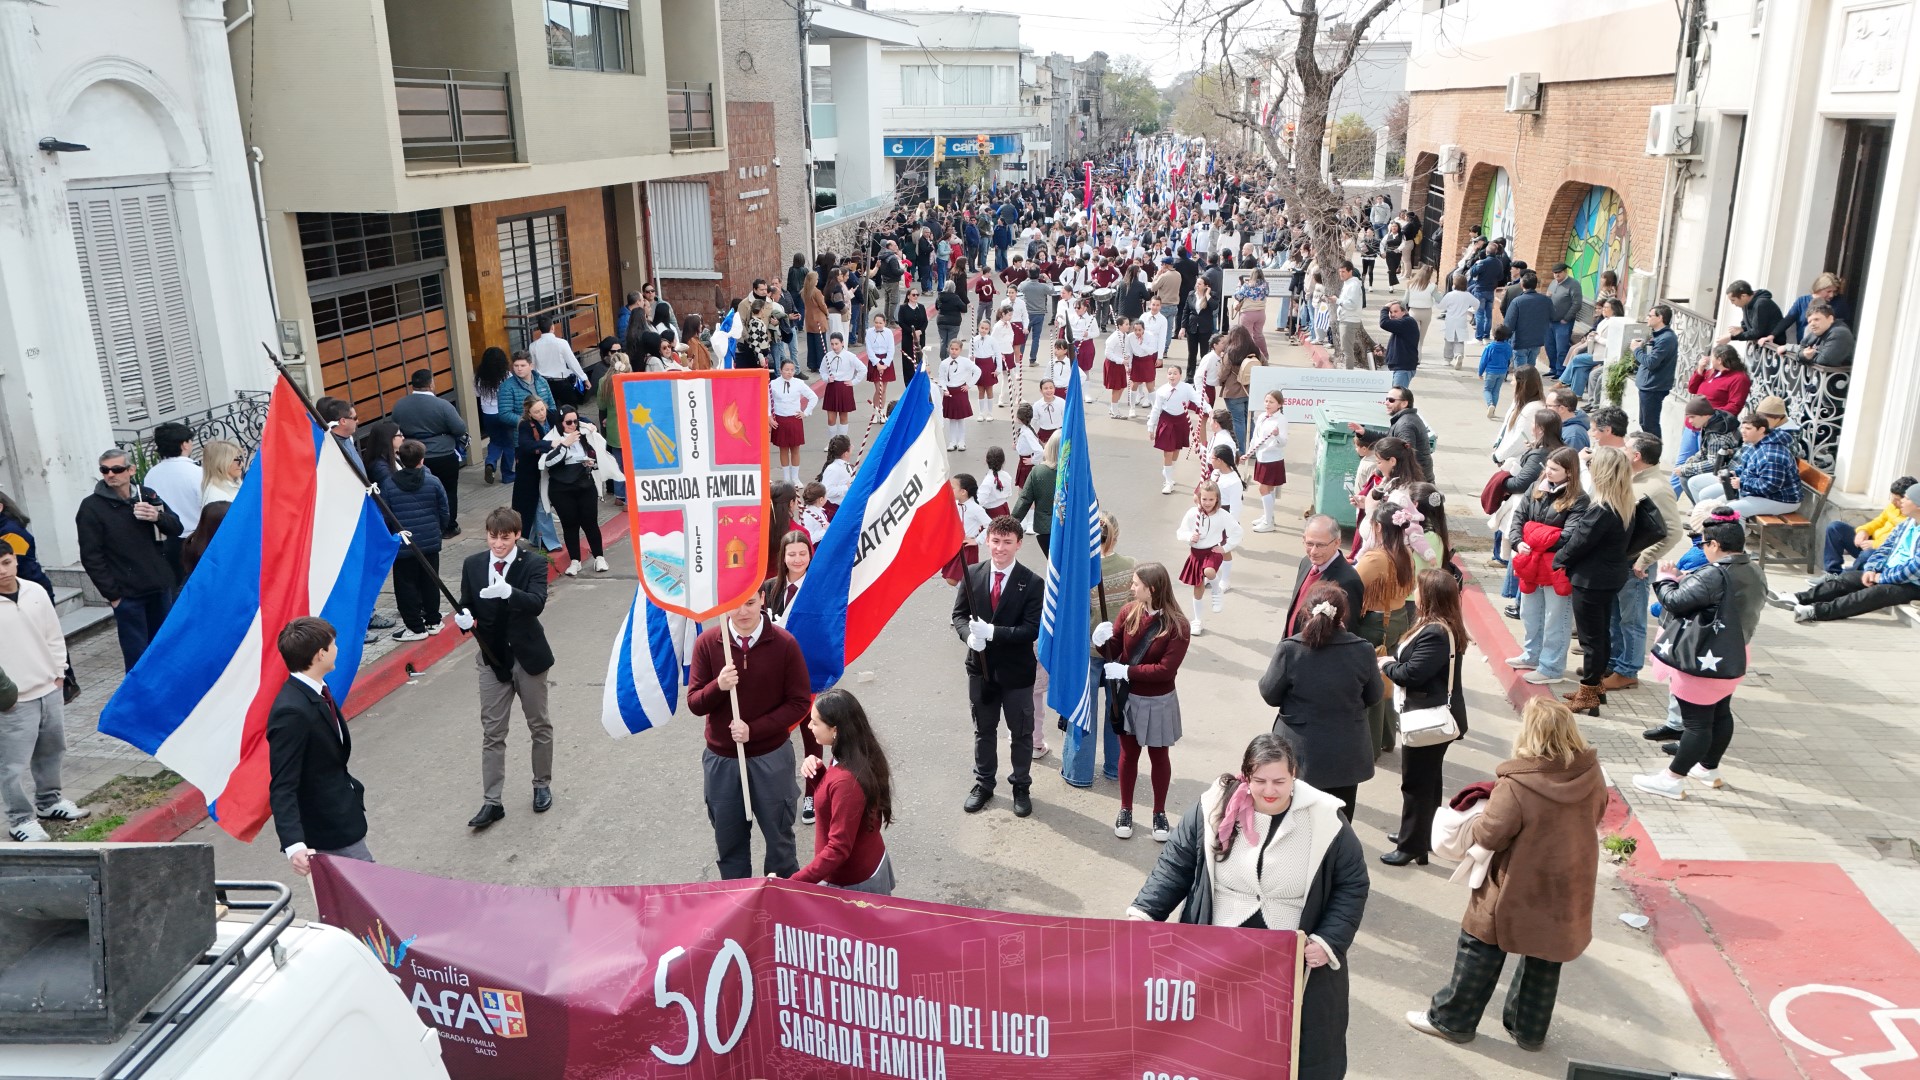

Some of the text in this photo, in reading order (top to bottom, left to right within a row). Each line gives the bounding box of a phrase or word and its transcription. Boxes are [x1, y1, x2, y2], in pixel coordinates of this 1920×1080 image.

[1301, 375, 1385, 385] ESPACIO RESERVADO
[1283, 397, 1314, 407] ESPACIO
[641, 474, 756, 502] SAGRADA FAMILIA
[774, 923, 899, 990] ANIVERSARIO
[410, 959, 470, 987] familia
[650, 938, 753, 1065] 50
[776, 966, 1049, 1058] DE LA FUNDACIÓN DEL LICEO
[1144, 977, 1196, 1022] 1976
[437, 1030, 496, 1049] AGRADA FAMILIA
[475, 1046, 498, 1057] SALTO
[779, 1009, 947, 1080] SAGRADA FAMILIA
